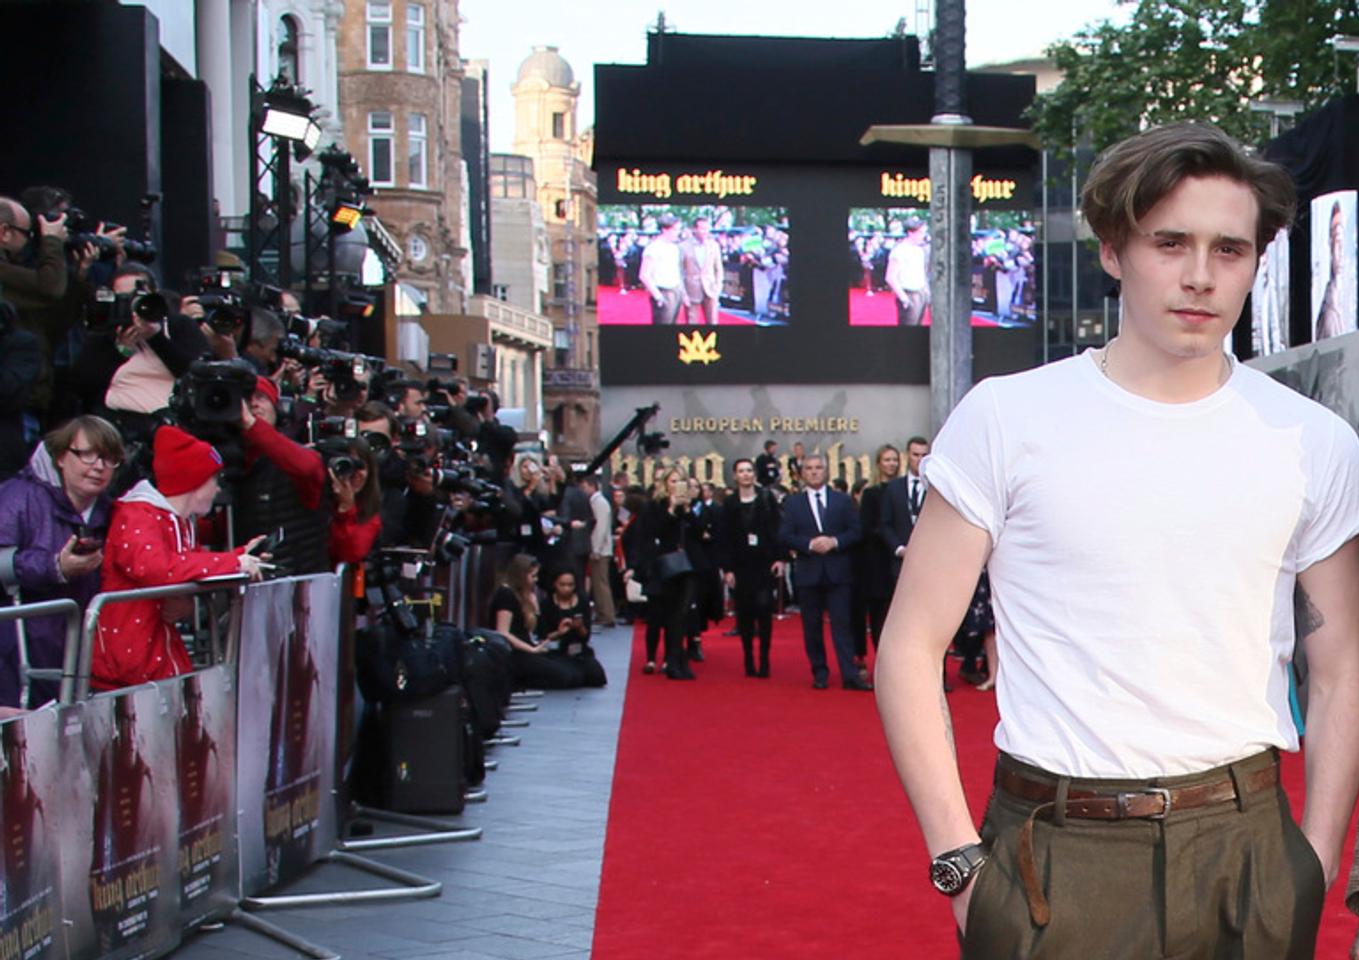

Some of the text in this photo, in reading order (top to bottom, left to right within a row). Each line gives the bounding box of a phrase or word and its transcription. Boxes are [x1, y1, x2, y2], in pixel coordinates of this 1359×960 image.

[617, 168, 756, 199] king arthur
[880, 172, 932, 202] king
[670, 417, 860, 433] EUROPEAN PREMIERE
